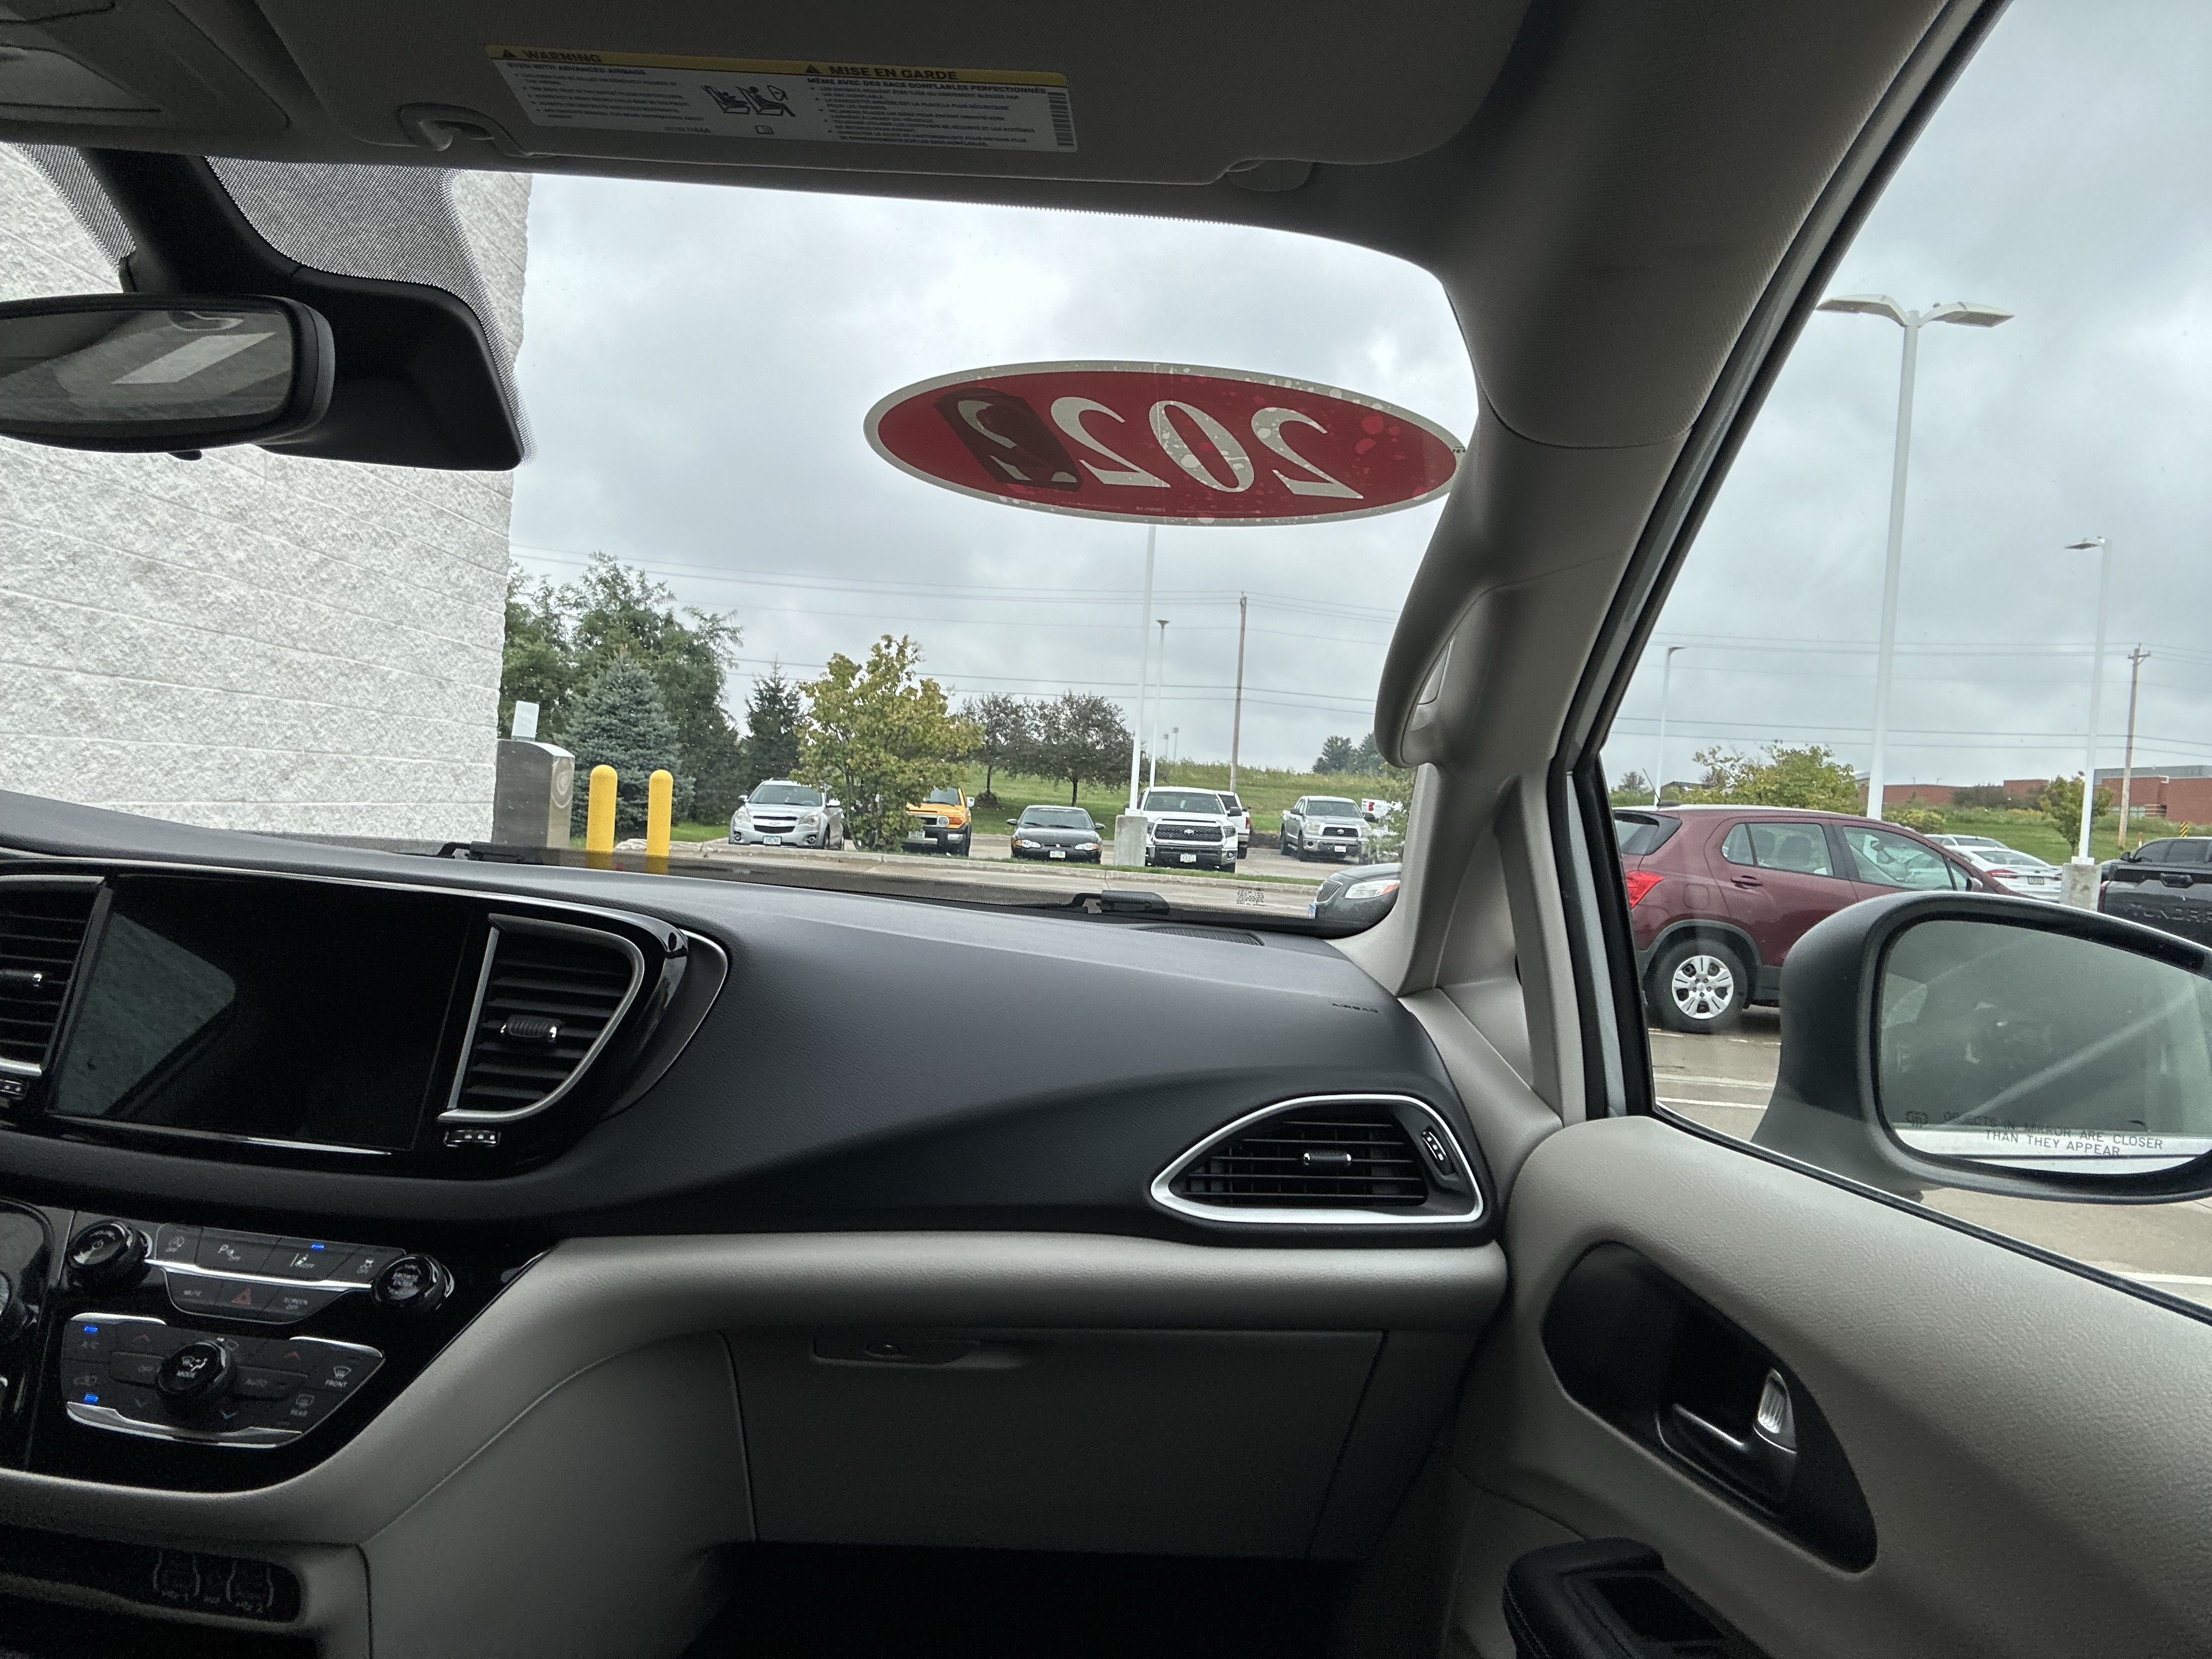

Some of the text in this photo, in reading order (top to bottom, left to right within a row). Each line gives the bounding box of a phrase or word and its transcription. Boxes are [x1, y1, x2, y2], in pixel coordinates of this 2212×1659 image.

[522, 50, 602, 63] WARNING
[829, 65, 958, 81] MISE EN GARDE
[970, 85, 1047, 94] PERFECTIONNÉS
[1985, 1130, 2120, 1156] THAN THEY APPEAR
[2024, 1123, 2071, 1137] MIRROR
[2080, 1130, 2104, 1143] ARE
[2113, 1135, 2163, 1150] CLOSER
[325, 1379, 347, 1388] FRONT
